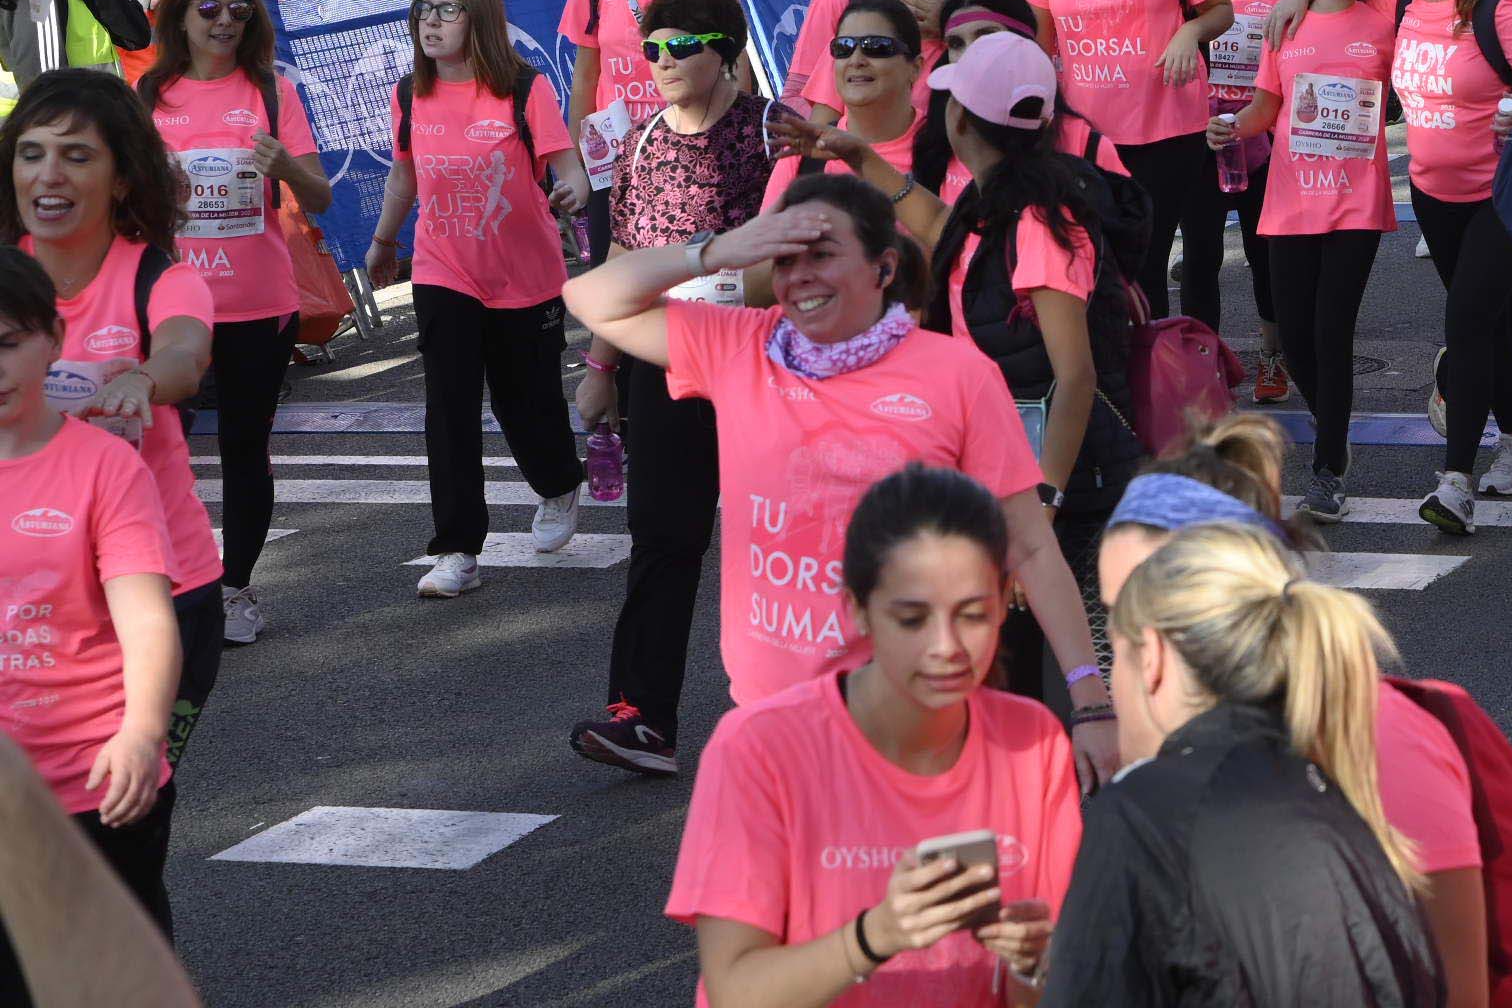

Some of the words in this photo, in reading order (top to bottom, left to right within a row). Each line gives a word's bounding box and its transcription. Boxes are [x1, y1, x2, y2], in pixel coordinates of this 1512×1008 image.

[1057, 15, 1083, 32] TU
[1066, 37, 1146, 57] DORSAL
[1212, 40, 1239, 52] 016
[608, 55, 634, 76] TU
[1395, 38, 1459, 75] HOY
[1072, 63, 1127, 82] SUMA
[614, 80, 659, 102] DOR
[1320, 107, 1351, 121] 016
[192, 161, 230, 173] ASTURIANA
[194, 183, 229, 197] 016
[197, 200, 226, 209] 28653
[749, 493, 787, 534] TU
[749, 544, 845, 596] DORS
[749, 592, 846, 646] SUMA
